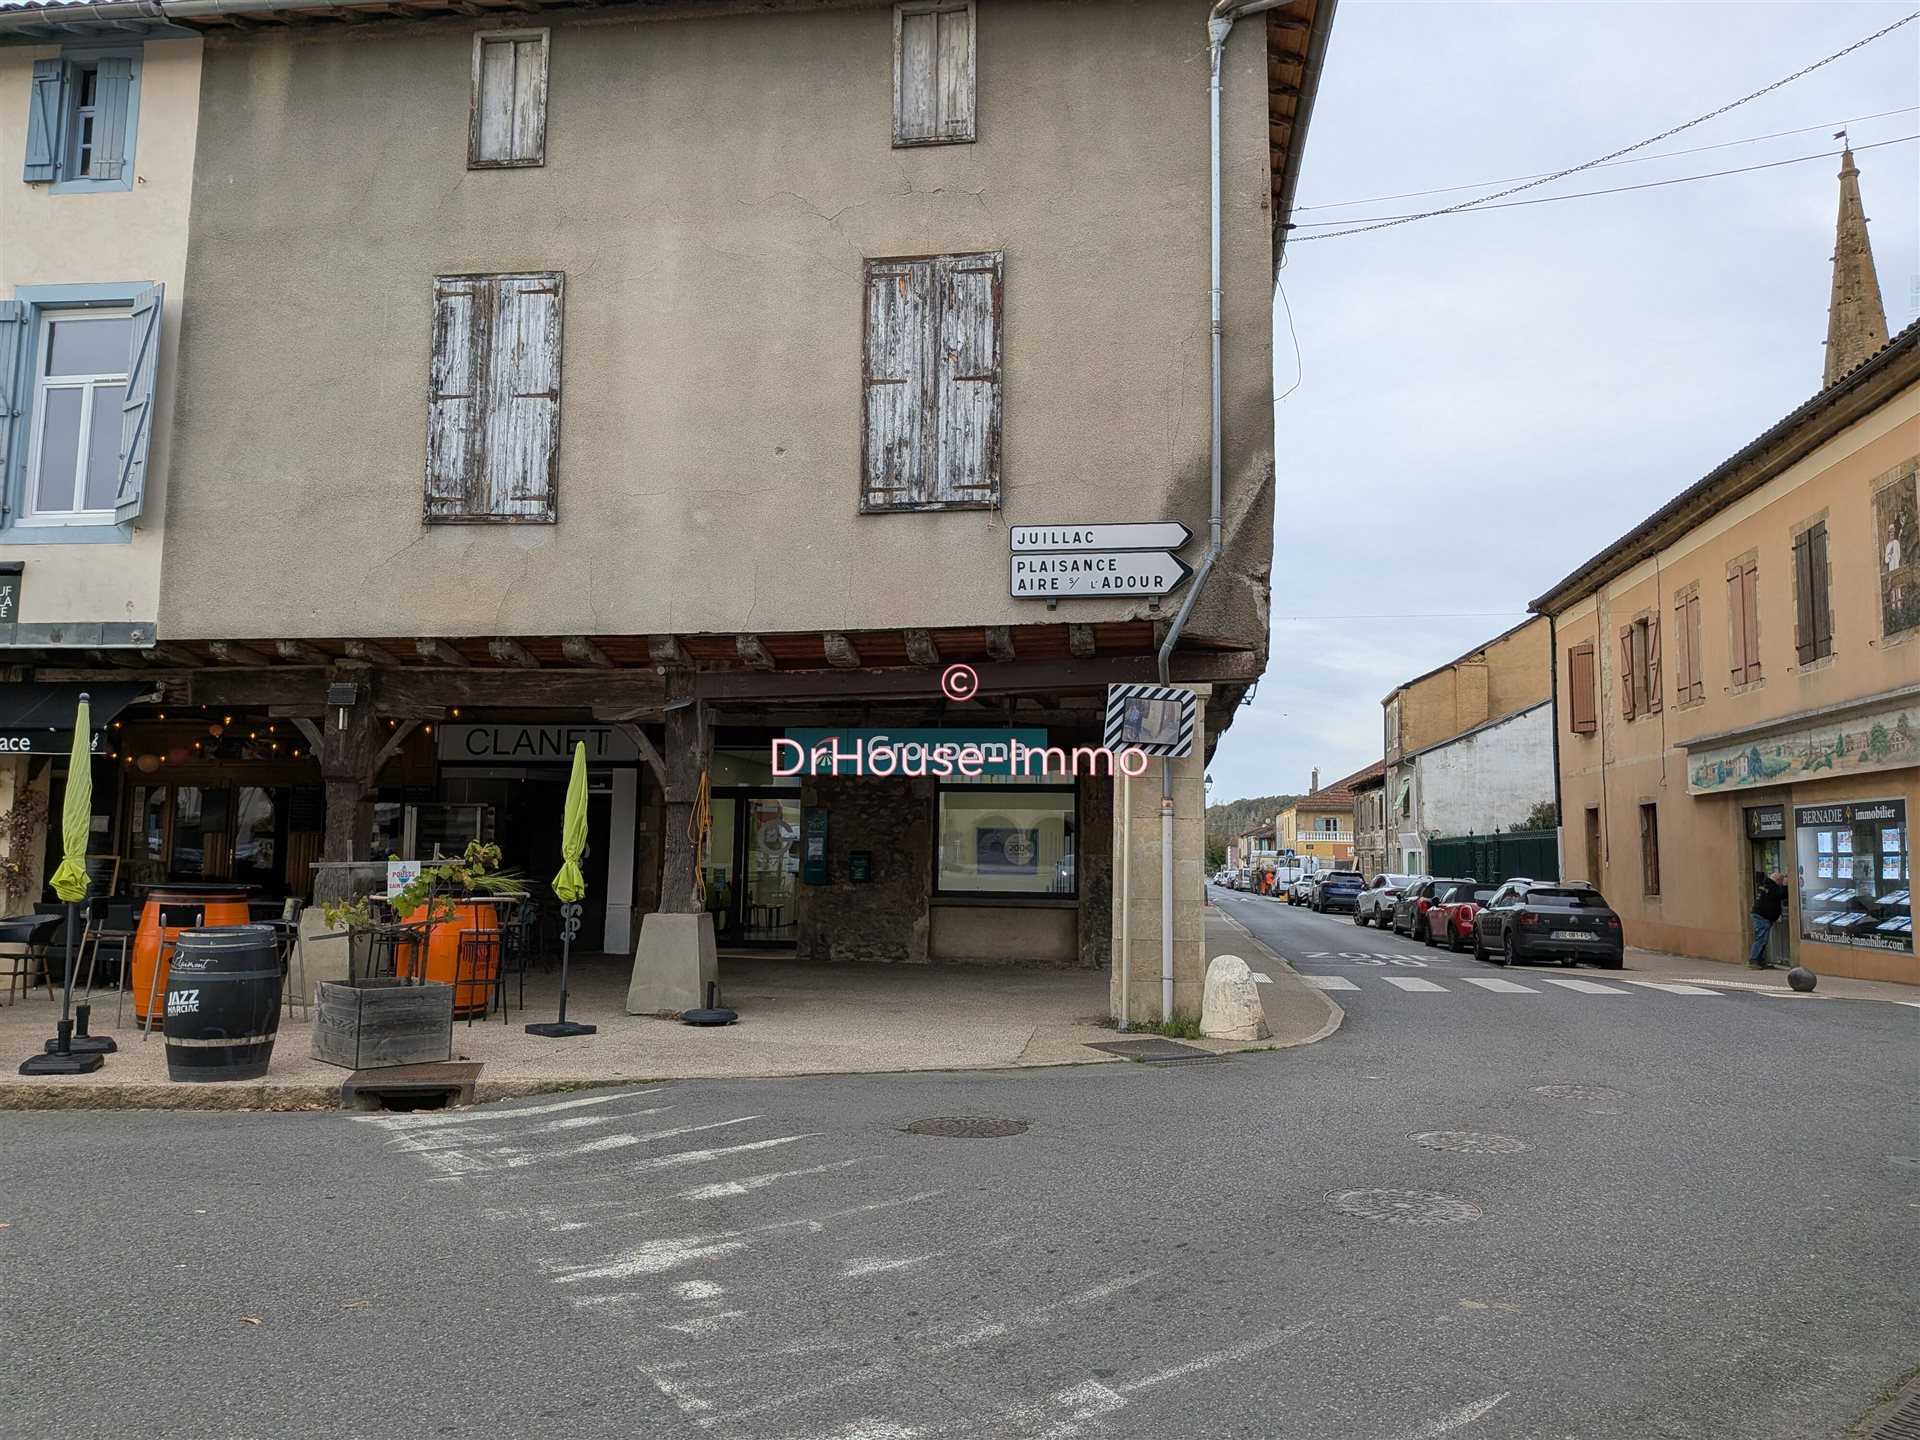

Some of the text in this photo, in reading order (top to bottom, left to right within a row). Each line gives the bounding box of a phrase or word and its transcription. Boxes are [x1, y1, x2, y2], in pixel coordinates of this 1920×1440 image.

[1017, 531, 1094, 545] JUILLAC
[1017, 559, 1117, 573] PLAISANCE
[1017, 577, 1059, 591] AIRE
[465, 728, 612, 756] CLANET
[867, 735, 1027, 767] Groupama
[1802, 805, 1896, 824] BERNADIE immobilier
[1810, 930, 1904, 951] www.bernadie-immobilier.com
[1301, 951, 1451, 962] ZONE
[168, 989, 200, 1006] JAZZ
[167, 1004, 200, 1016] MARCIAC
